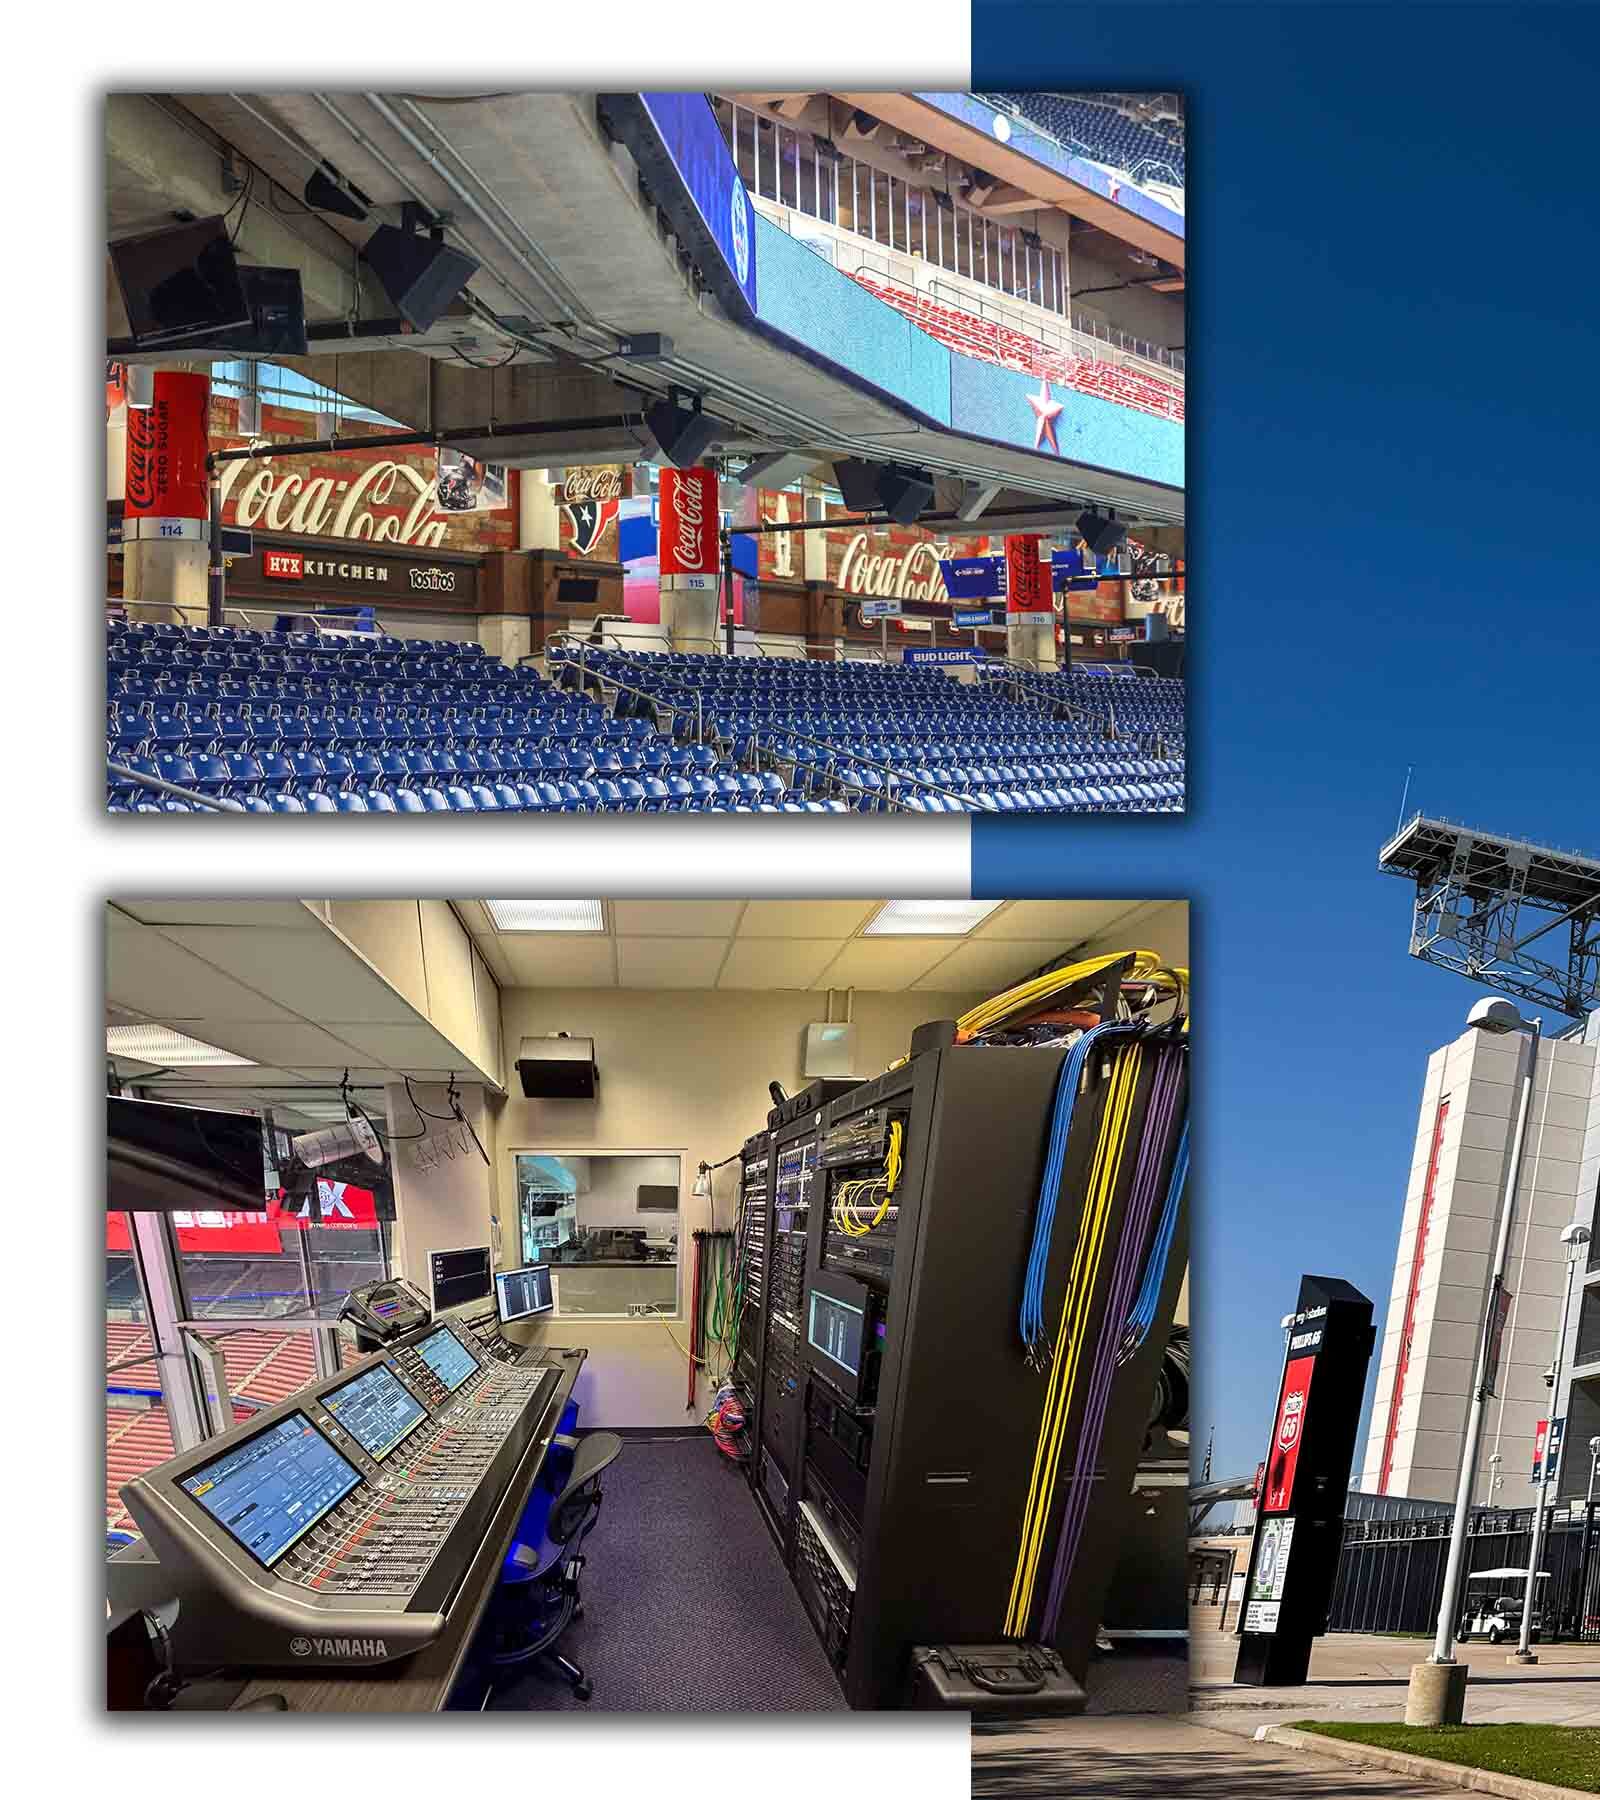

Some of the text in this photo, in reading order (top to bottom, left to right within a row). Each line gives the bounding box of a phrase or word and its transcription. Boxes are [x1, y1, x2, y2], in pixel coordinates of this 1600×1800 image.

[127, 408, 155, 508] Coca-Col
[564, 470, 622, 500] Coca-Cola
[160, 525, 183, 537] 114
[673, 471, 703, 570] Coca-Cola
[270, 556, 388, 581] HTX KITCHEN
[689, 579, 704, 588] 115
[913, 651, 970, 662] BUD LIGHT
[1281, 1417, 1298, 1440] 66
[1364, 1524, 1427, 1539] PHILLIPS
[1467, 1518, 1508, 1534] GATE
[312, 1639, 388, 1657] YAMAHA
